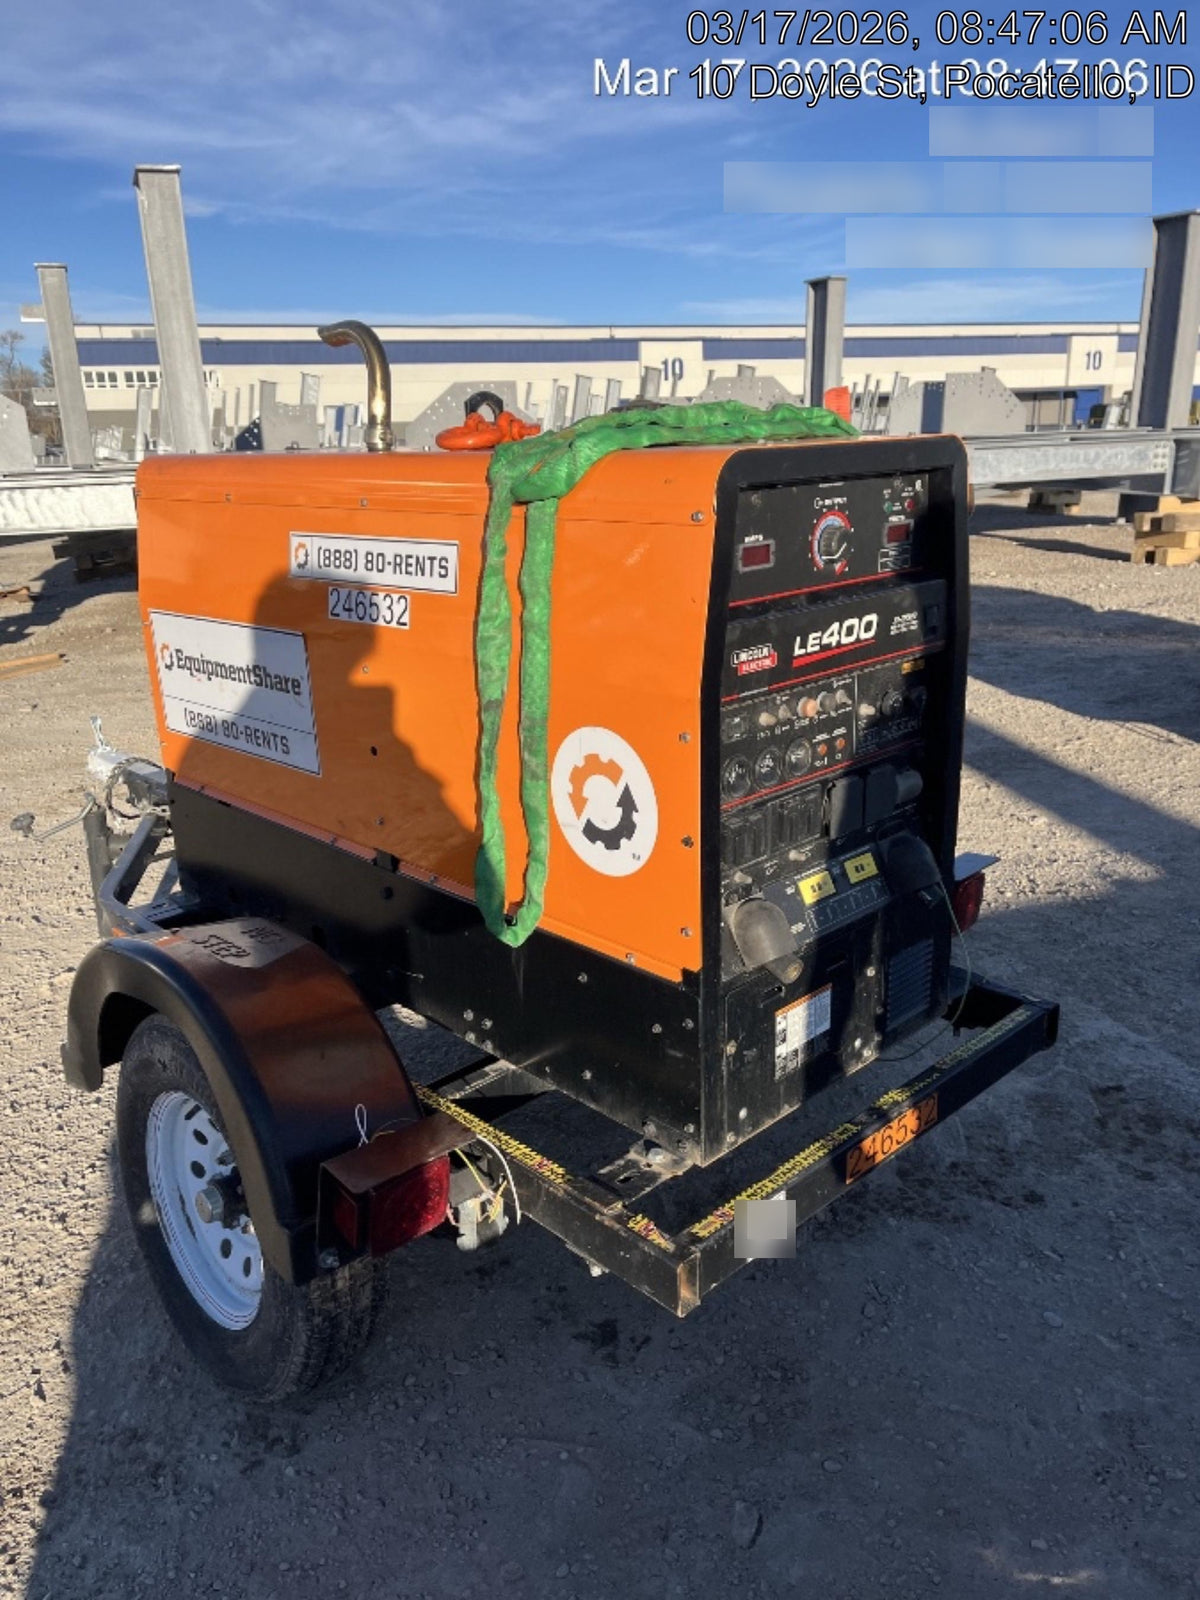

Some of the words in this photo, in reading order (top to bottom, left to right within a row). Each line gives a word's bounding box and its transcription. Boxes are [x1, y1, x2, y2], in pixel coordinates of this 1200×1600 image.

[660, 357, 684, 381] 10
[1085, 350, 1103, 370] 10
[317, 546, 358, 573] (888)
[364, 550, 449, 579] 80-RENTS
[329, 587, 409, 627] 246532
[174, 648, 303, 697] EquipmentShare
[847, 1094, 937, 1179] 246532
